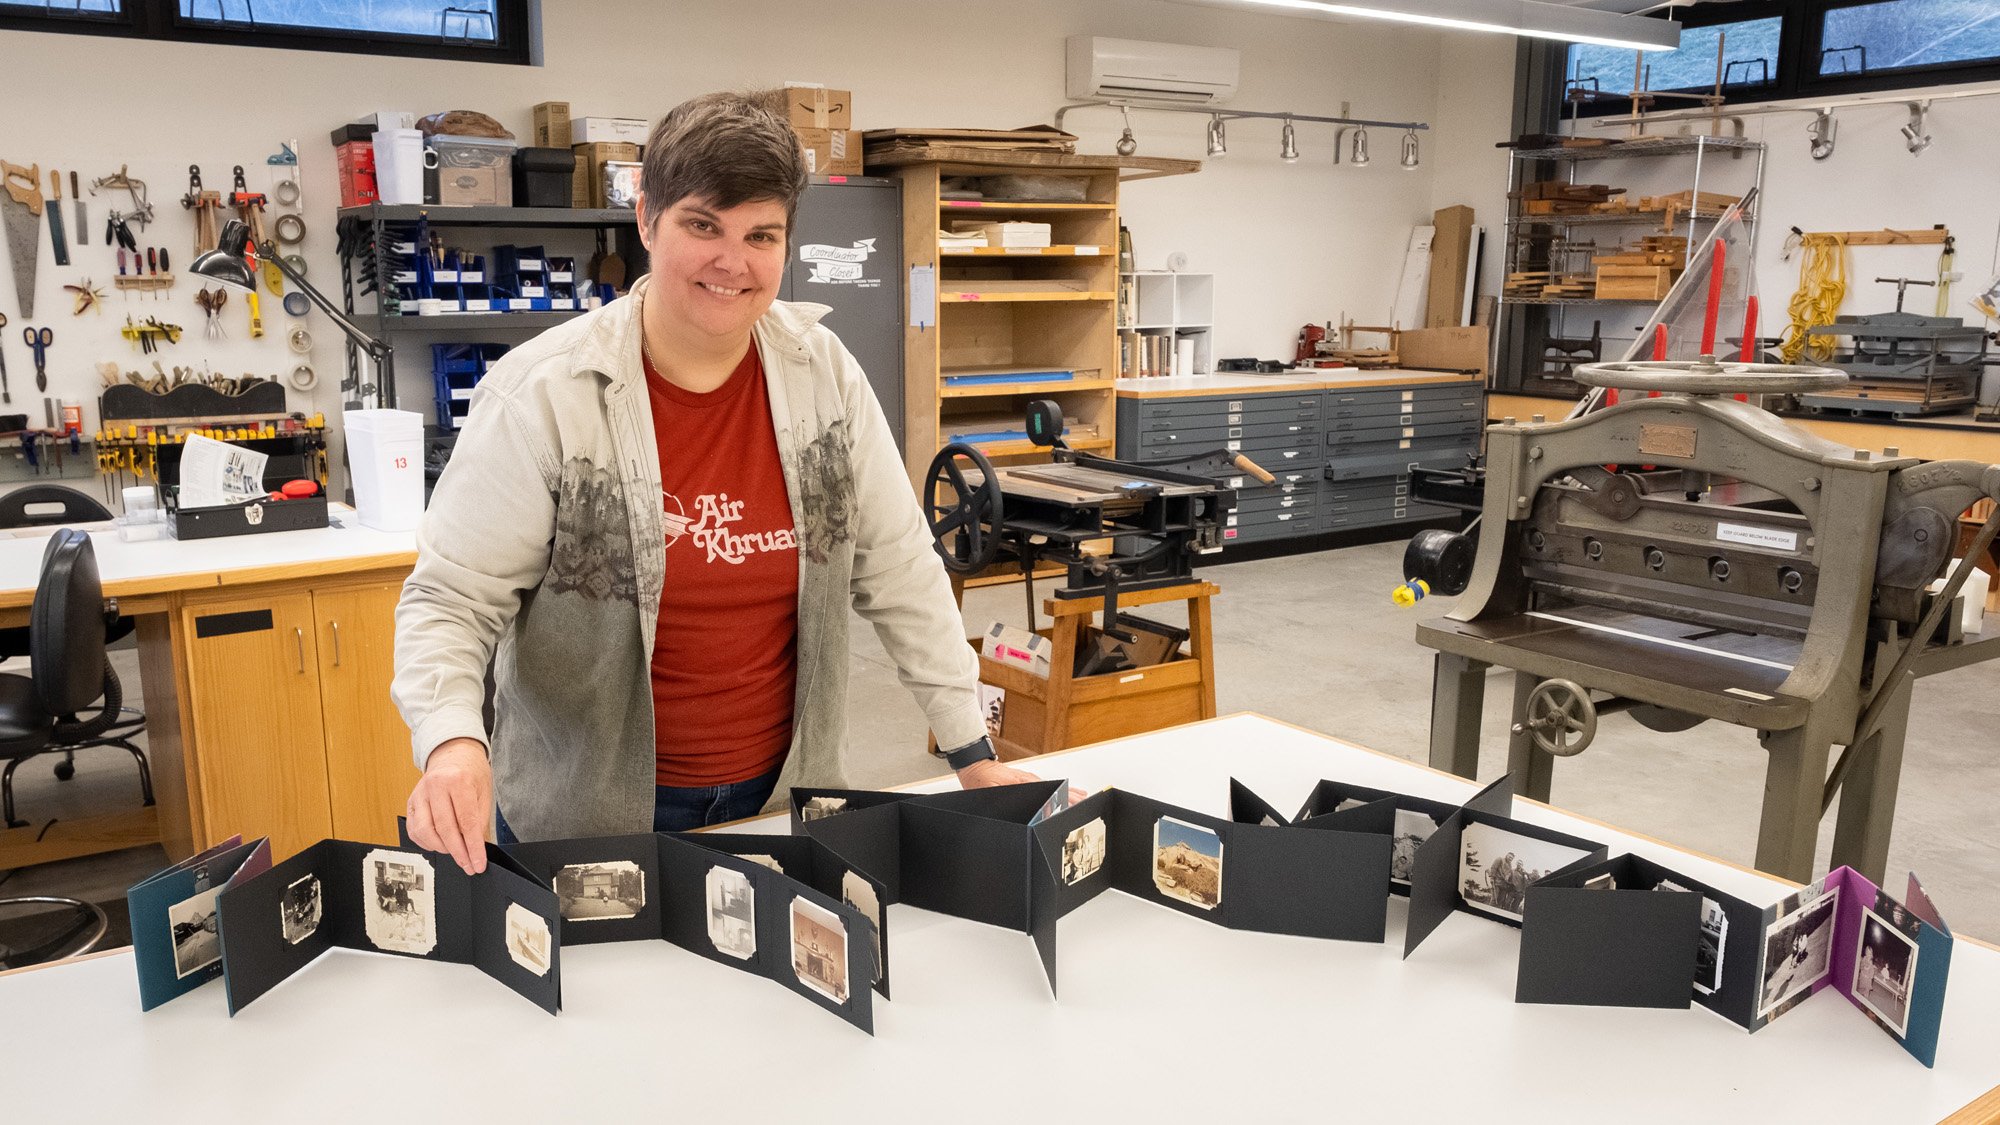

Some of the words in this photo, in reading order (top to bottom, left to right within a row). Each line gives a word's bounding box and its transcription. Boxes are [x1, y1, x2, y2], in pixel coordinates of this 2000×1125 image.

[809, 246, 859, 260] Coordinator
[394, 457, 407, 469] 13
[688, 493, 745, 533] Air
